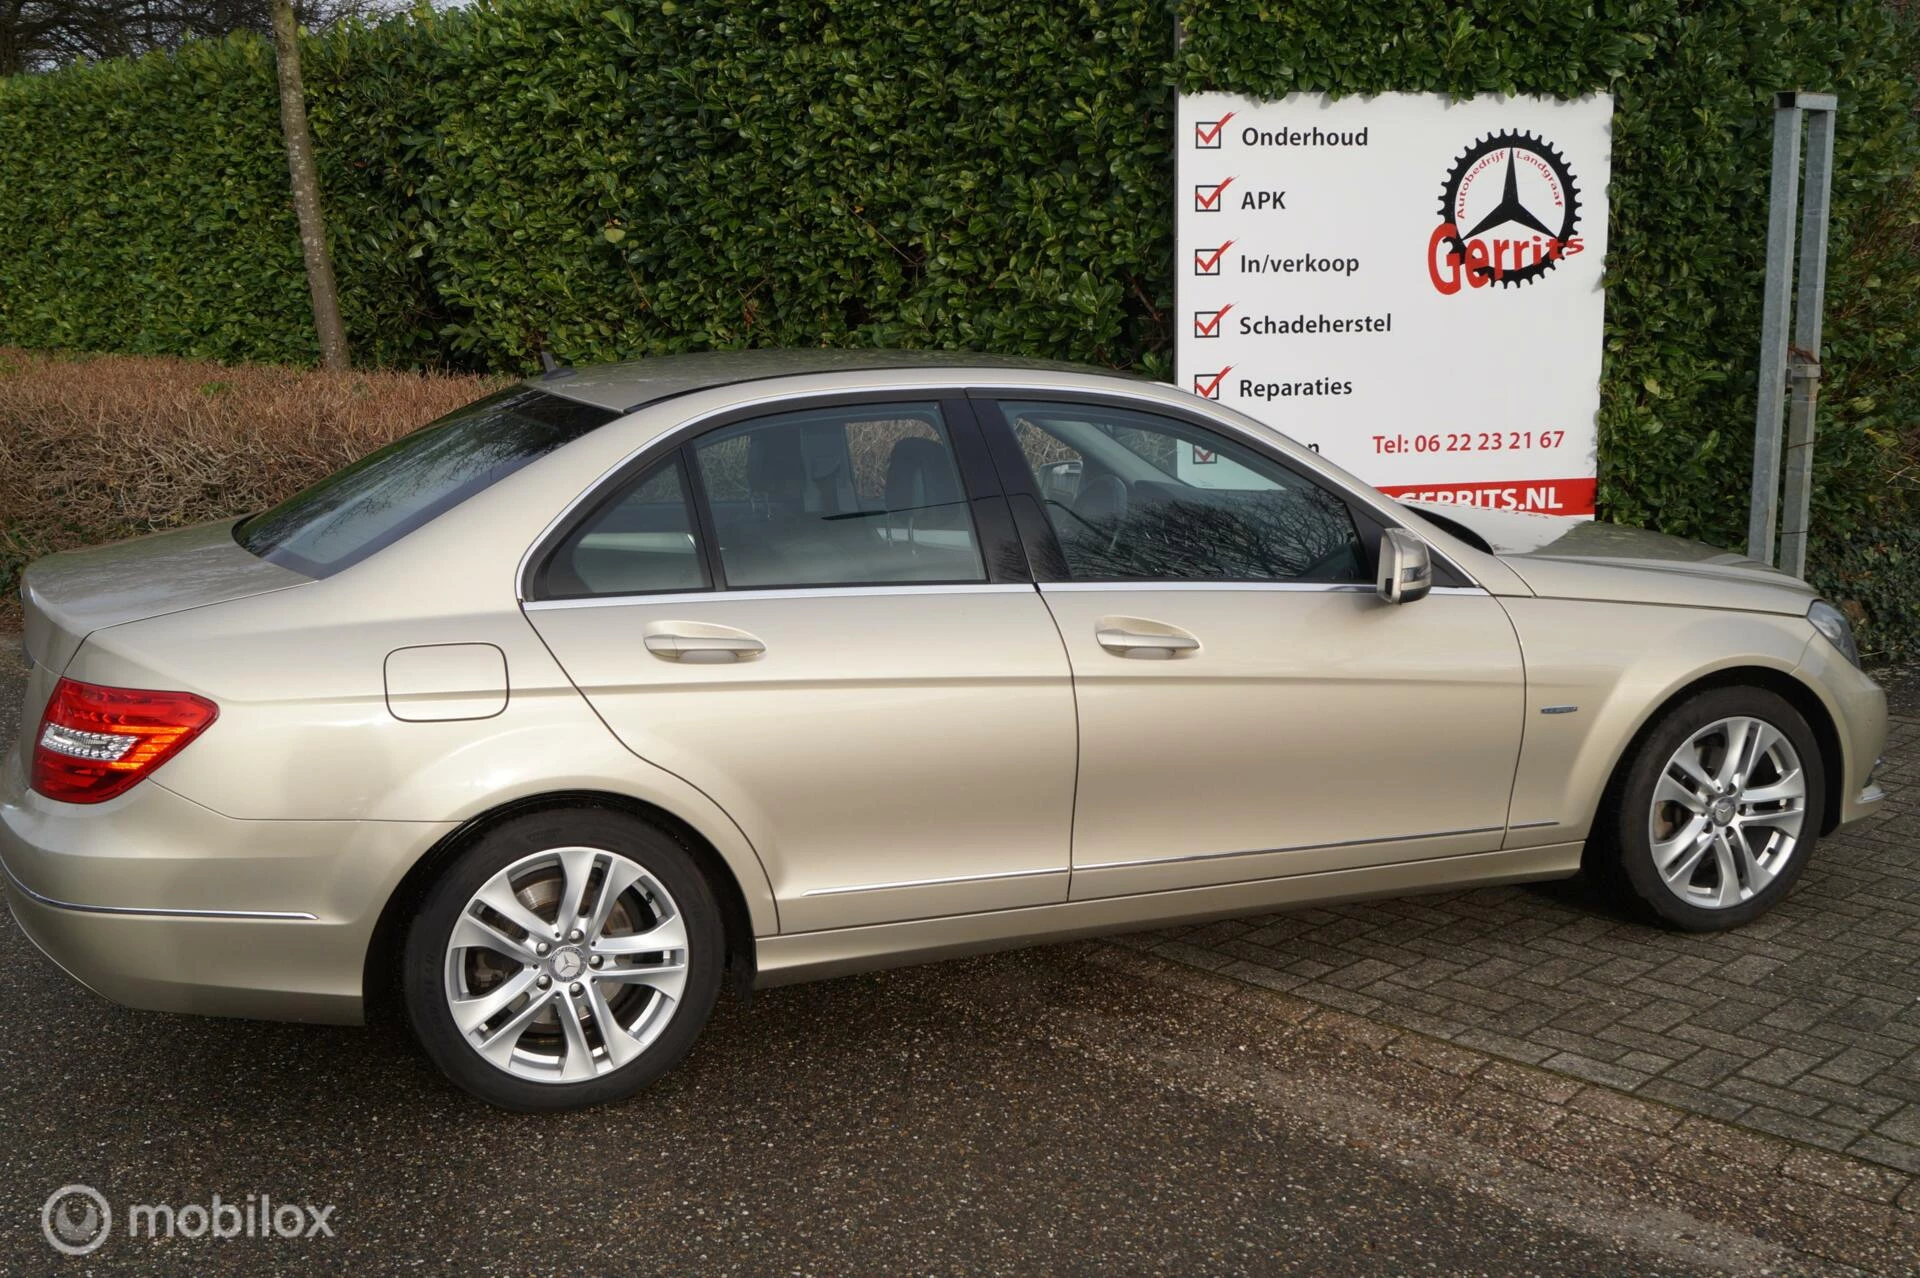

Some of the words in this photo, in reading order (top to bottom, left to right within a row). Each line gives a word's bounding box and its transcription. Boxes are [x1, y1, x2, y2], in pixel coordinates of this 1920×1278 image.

[1242, 126, 1368, 146] Onderhoud
[1457, 150, 1506, 219] Autobedrijf
[1516, 150, 1563, 208] Landgraaf
[1241, 191, 1286, 210] APK
[1241, 253, 1360, 277] In/verkoop
[1428, 222, 1584, 295] Gerrits
[1240, 312, 1391, 335] Schadeherstel
[1240, 377, 1353, 402] Reparaties
[1373, 435, 1409, 453] Tel:
[1415, 435, 1441, 452] 06
[1446, 433, 1471, 451] 22
[1478, 433, 1502, 450] 23
[1509, 432, 1531, 449] 21
[1540, 431, 1565, 448] 67
